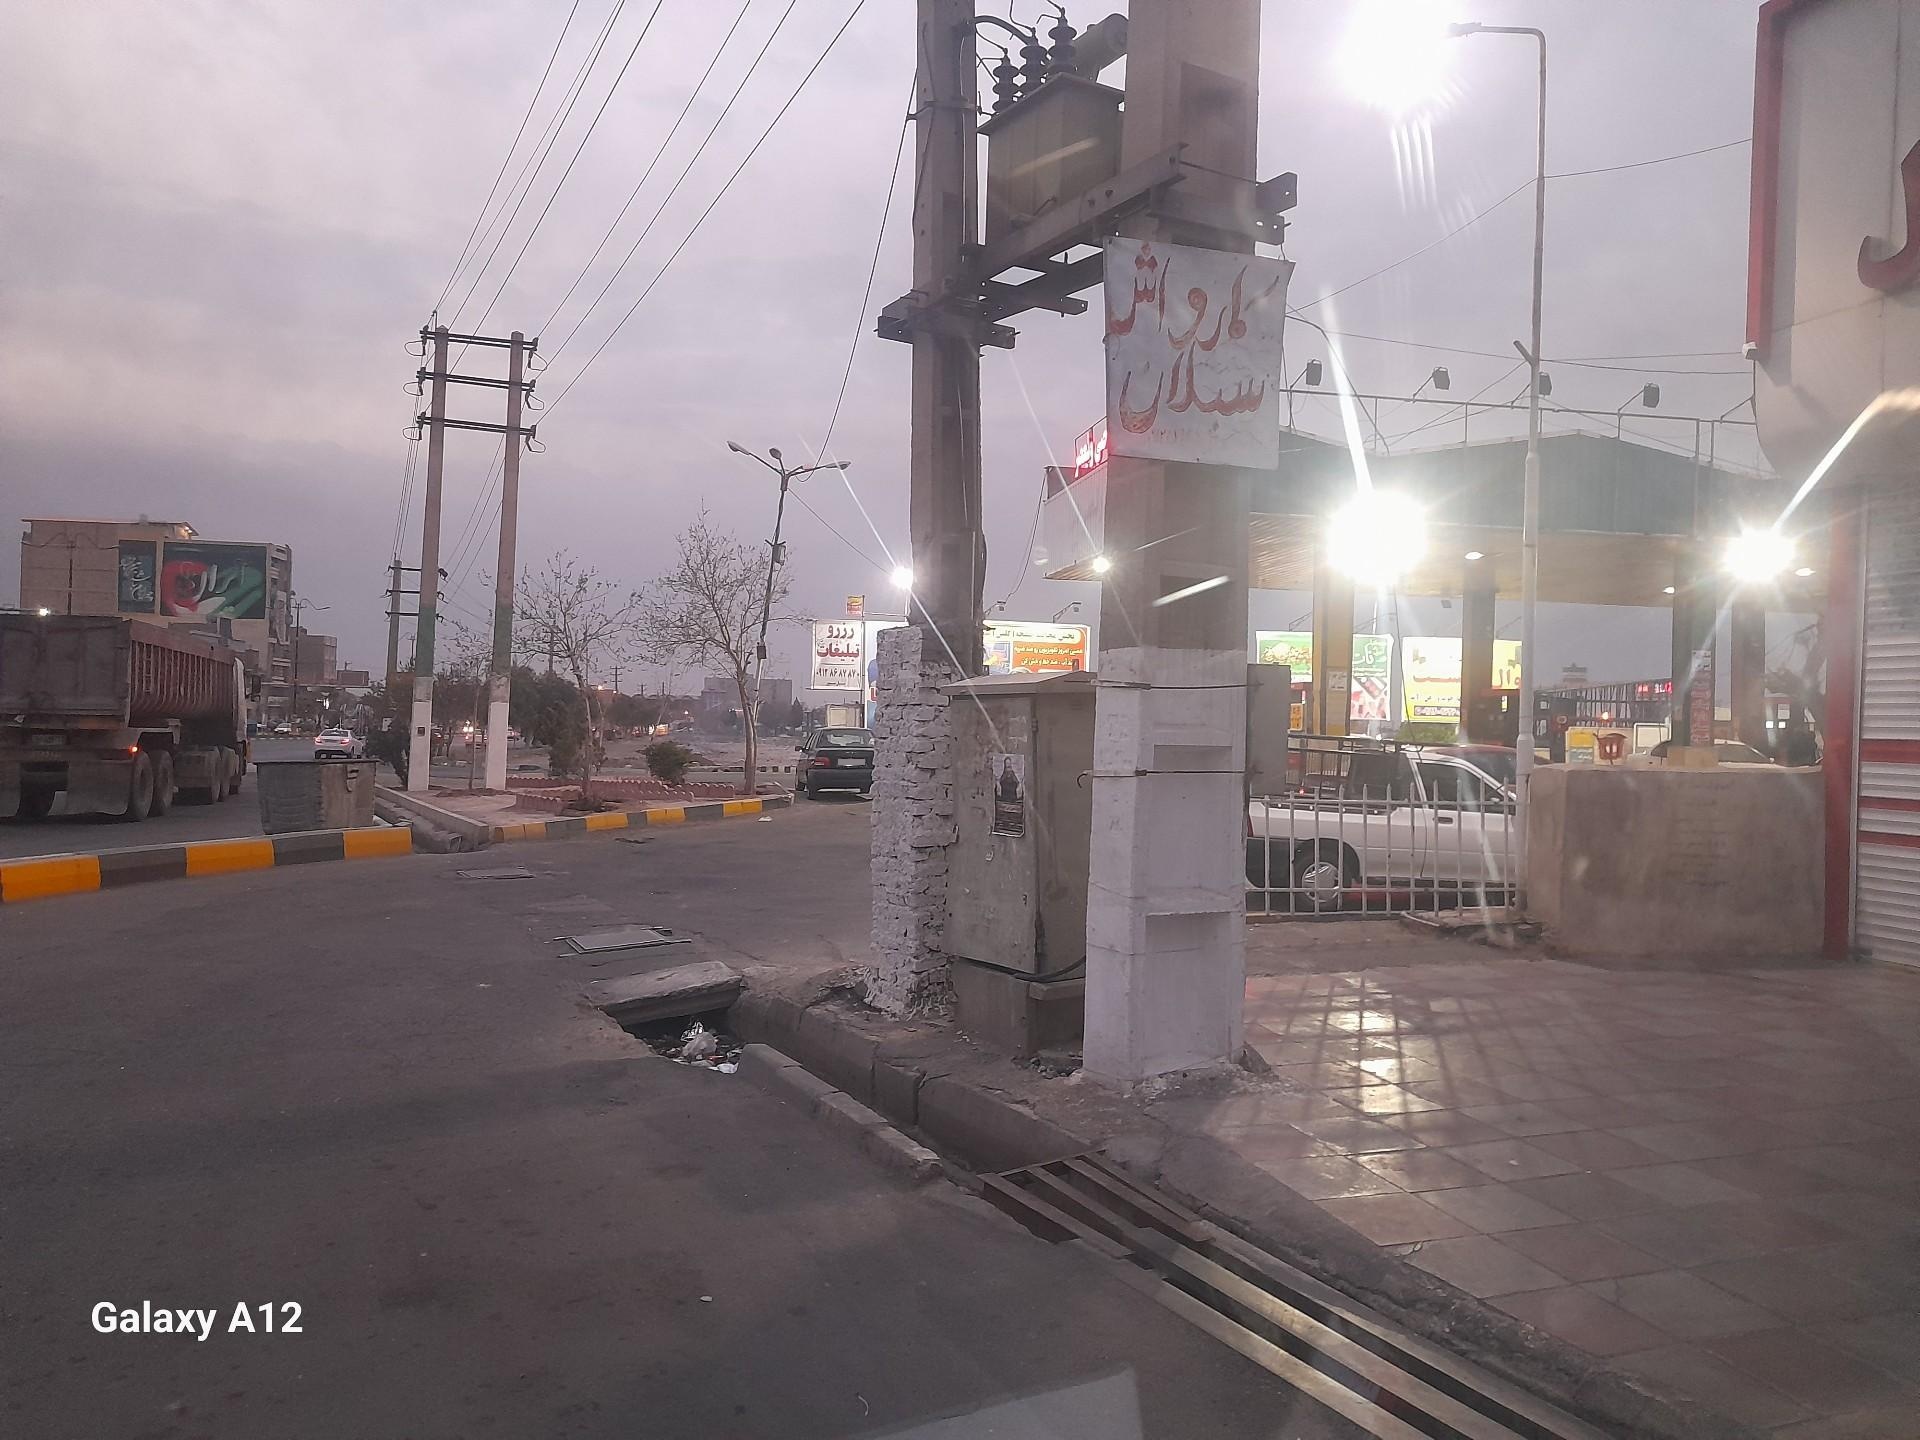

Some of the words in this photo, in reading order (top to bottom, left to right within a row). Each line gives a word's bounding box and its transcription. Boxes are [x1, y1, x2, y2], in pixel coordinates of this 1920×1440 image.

[1108, 241, 1280, 351] کارواش
[826, 622, 854, 639] رزرو
[817, 643, 860, 662] تبلیغات
